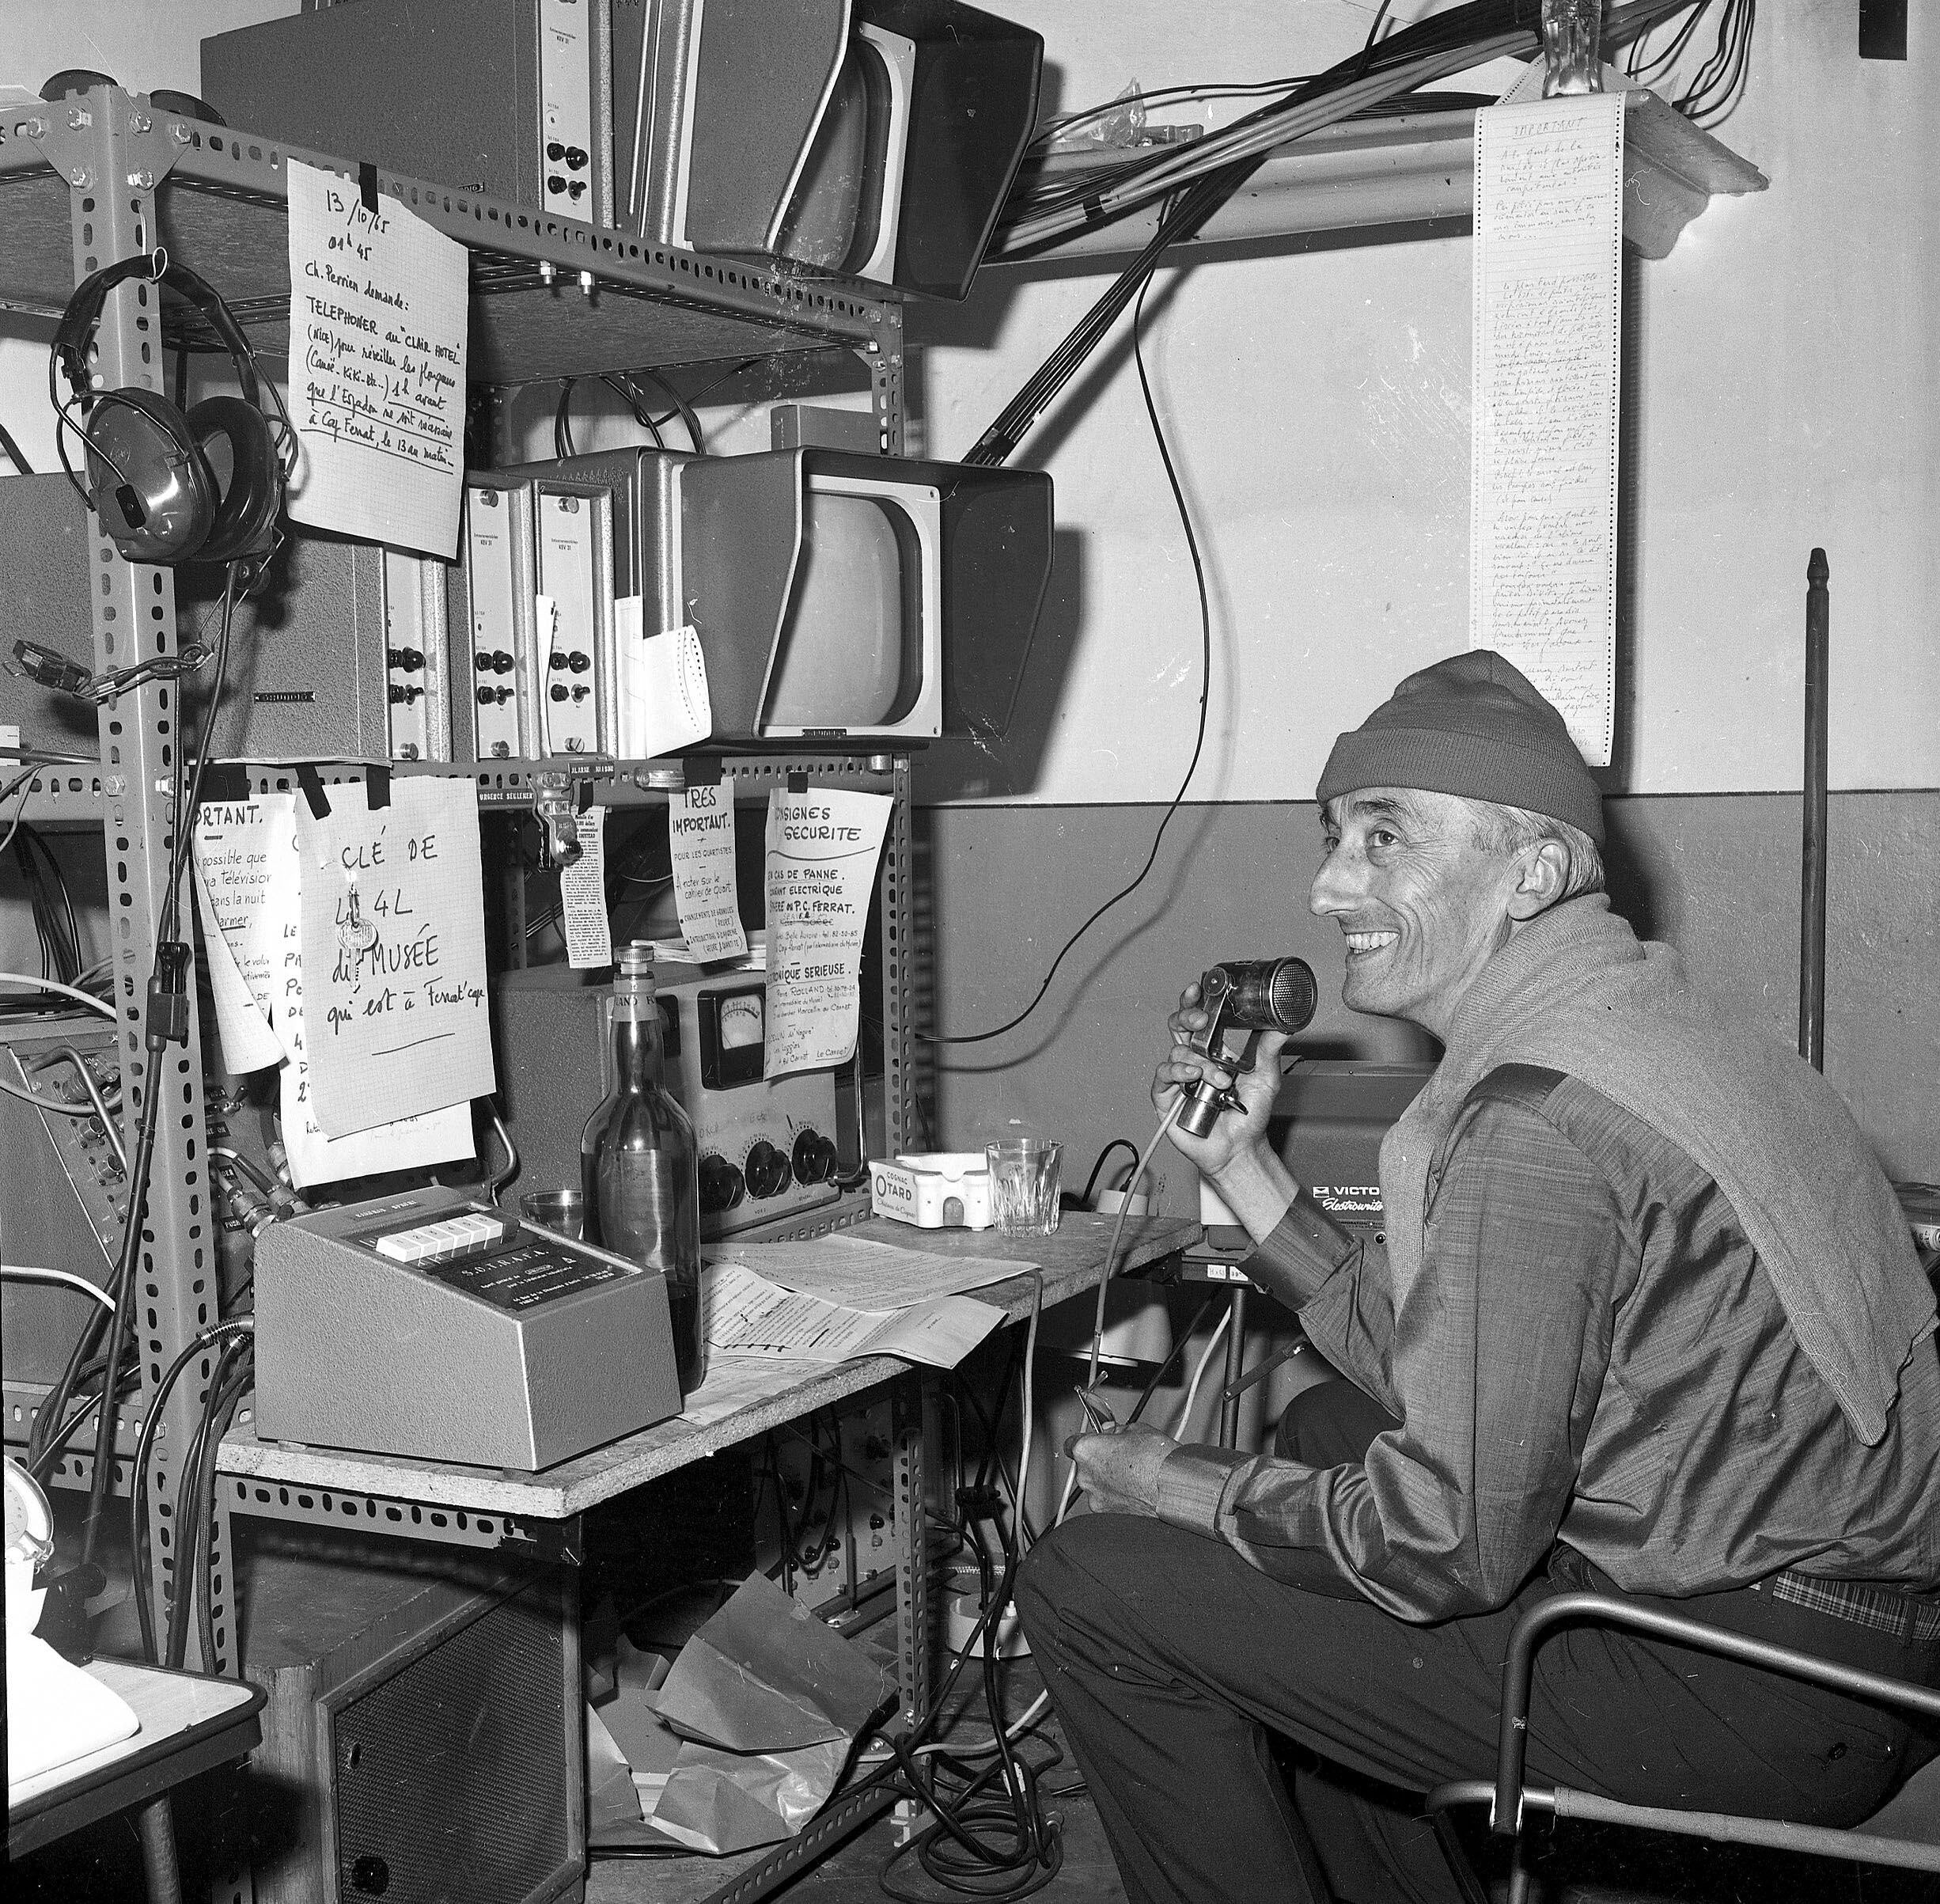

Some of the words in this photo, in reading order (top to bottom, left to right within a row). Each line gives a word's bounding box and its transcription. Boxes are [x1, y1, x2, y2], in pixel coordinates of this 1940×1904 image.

[327, 189, 390, 234] 13/10/65
[357, 244, 372, 261] 45
[305, 260, 324, 279] Ch.
[306, 295, 378, 335] TELEPHONER
[385, 332, 401, 344] au
[401, 355, 415, 374] les
[307, 381, 326, 407] que
[382, 408, 394, 419] ne
[415, 393, 447, 410] avant
[309, 408, 319, 425] à
[321, 411, 341, 443] Cap
[381, 430, 391, 448] le
[397, 438, 407, 453] 13
[479, 792, 503, 801] URGENCE
[673, 812, 731, 836] IMPORTANT.
[783, 825, 862, 840] SECURITE
[342, 825, 386, 870] CLÉ
[408, 835, 438, 861] DE
[674, 851, 690, 862] POUR
[692, 849, 703, 859] LES
[246, 853, 267, 870] que
[787, 869, 799, 879] DE
[233, 890, 242, 906] la
[244, 889, 266, 905] nuit
[374, 888, 413, 918] 4L
[813, 900, 855, 914] FERRAT.
[372, 923, 438, 976] MUSÉE
[327, 1000, 353, 1036] qui
[362, 988, 397, 1016] est
[403, 991, 415, 1011] à
[876, 1174, 912, 1201] OTARD
[886, 1171, 908, 1185] COGNAC
[1333, 1186, 1380, 1196] VICTO
